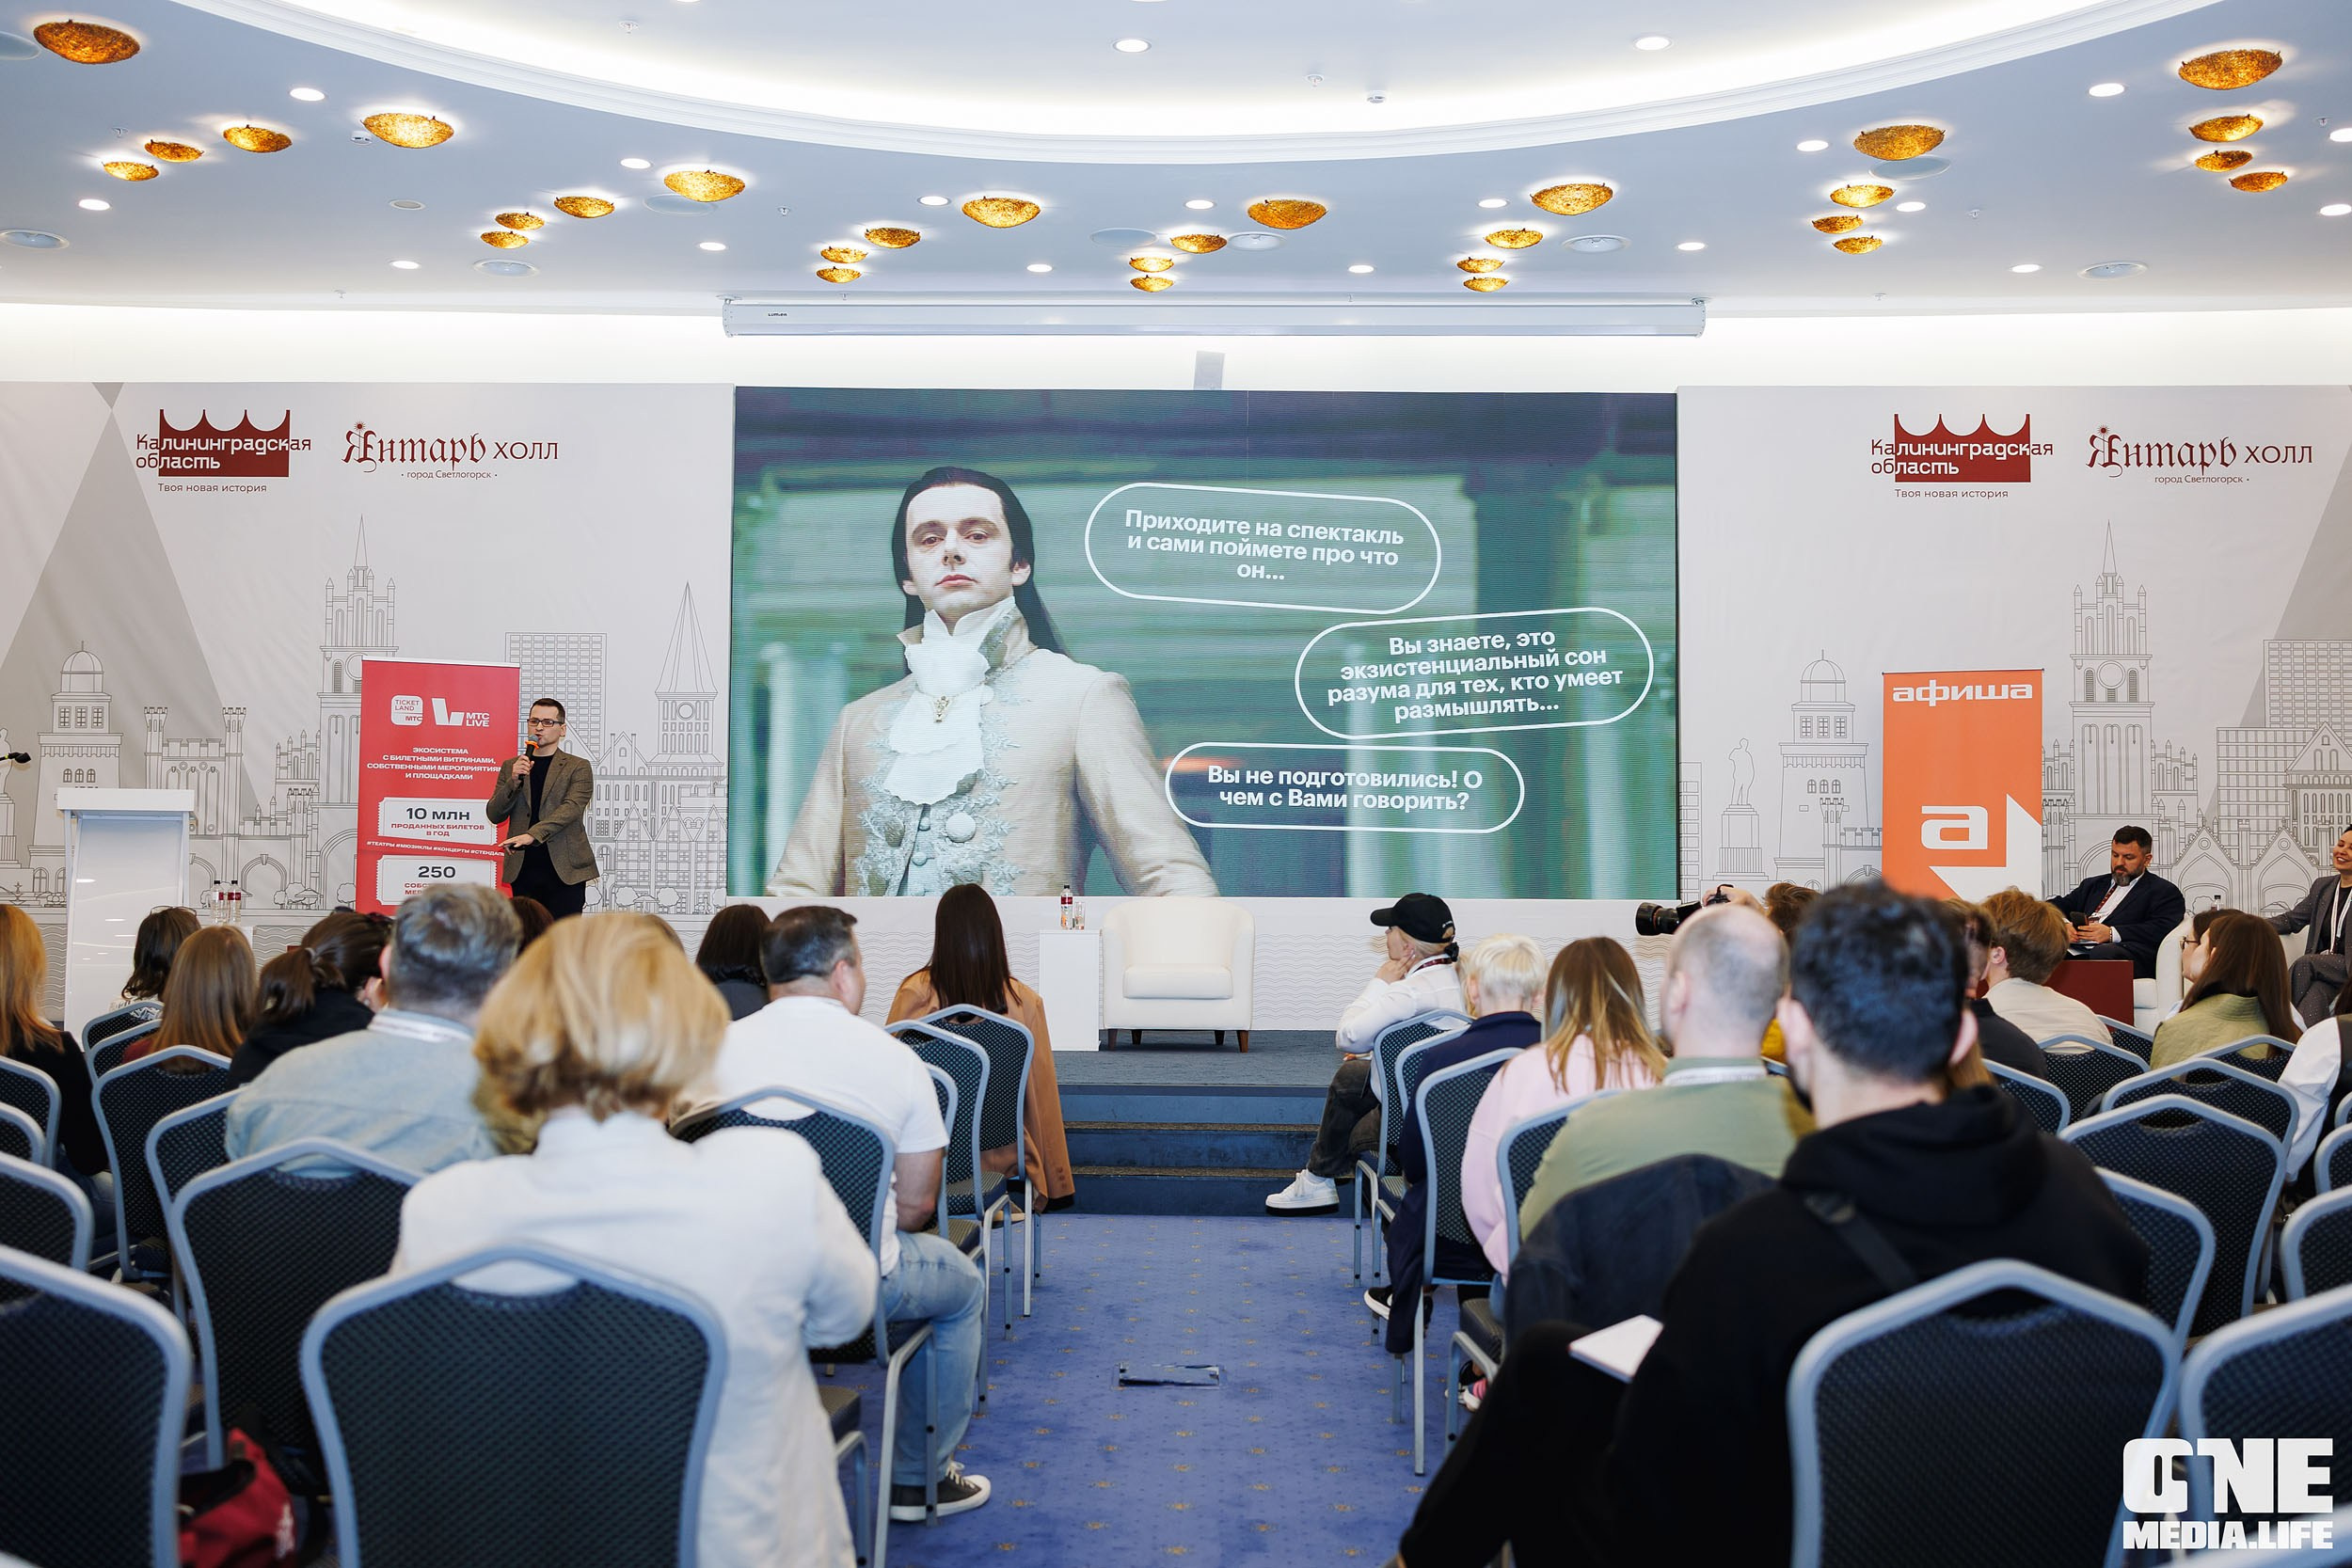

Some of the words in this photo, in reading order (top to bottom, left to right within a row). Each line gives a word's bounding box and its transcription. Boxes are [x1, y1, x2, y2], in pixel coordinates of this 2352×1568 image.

[136, 434, 310, 455] Калининградская
[1871, 439, 2053, 460] Калининградская
[135, 453, 221, 468] область
[1871, 458, 1960, 475] область
[407, 471, 434, 480] город
[435, 470, 492, 480] Светлогорск
[2154, 476, 2183, 484] город
[2185, 474, 2244, 484] Светлогорск
[158, 483, 183, 492] Твоя
[221, 484, 267, 494] история
[1895, 489, 1921, 498] Твоя
[1962, 490, 2009, 499] история
[1125, 509, 1251, 534] Приходите
[1255, 520, 1282, 536] на
[1287, 524, 1404, 545] спектакль
[1128, 533, 1141, 549] и
[1147, 535, 1205, 553] сами
[1209, 537, 1307, 560] поймете
[1312, 546, 1355, 565] про
[1360, 549, 1398, 565] что
[1237, 563, 1285, 580] он...
[1390, 637, 1422, 656] Вы
[1426, 634, 1511, 653] знаете,
[1516, 631, 1555, 646] это
[1341, 649, 1560, 680] экзистенциальный
[1564, 648, 1607, 665] сон
[1327, 683, 1411, 706] разума
[1415, 680, 1456, 701] для
[1461, 677, 1505, 695] тех,
[1511, 673, 1549, 689] кто
[1554, 669, 1623, 690] умеет
[1892, 679, 2033, 706] афиша
[1394, 695, 1559, 723] размышлять...
[1208, 765, 1239, 784] Вы
[1245, 769, 1273, 784] не
[1279, 769, 1456, 788] подготовились!
[1464, 771, 1483, 788] О
[1219, 791, 1263, 806] чем
[1268, 792, 1282, 806] с
[1288, 788, 1346, 807] Вами
[1353, 792, 1470, 814] говорить?
[406, 807, 427, 820] 10
[418, 866, 456, 878] 250
